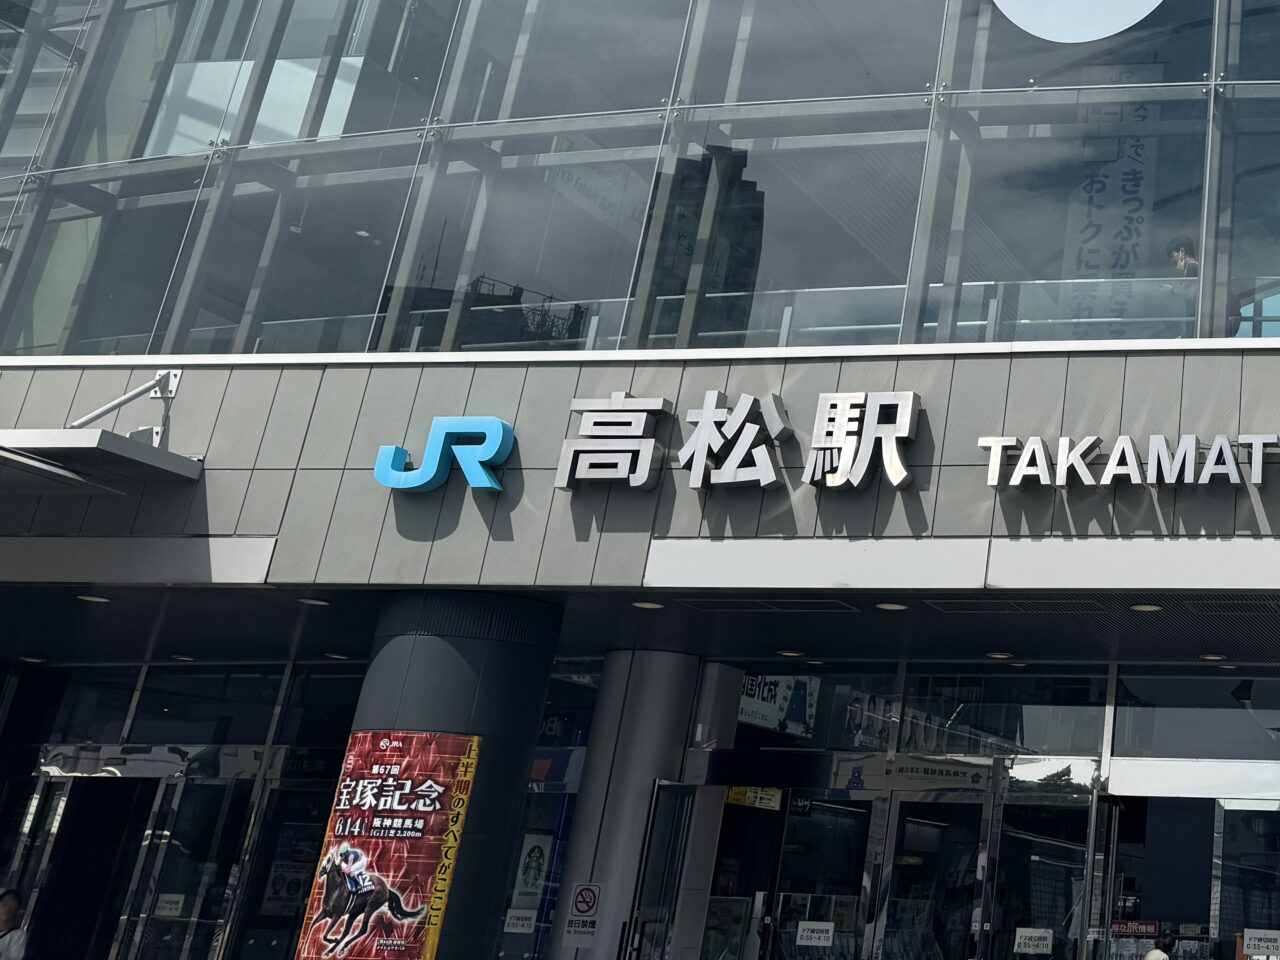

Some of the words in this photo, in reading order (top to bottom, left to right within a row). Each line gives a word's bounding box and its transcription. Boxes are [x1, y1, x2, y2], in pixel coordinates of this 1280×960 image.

[374, 415, 515, 493] JR
[554, 390, 922, 492] 高松駅
[371, 764, 400, 775] 第67回
[336, 778, 445, 812] 宝塚記念
[334, 816, 361, 837] 6.14
[372, 817, 424, 828] 阪神競馬場
[426, 743, 478, 926] 上半期のすべてがここに
[567, 919, 597, 928] 終日禁煙
